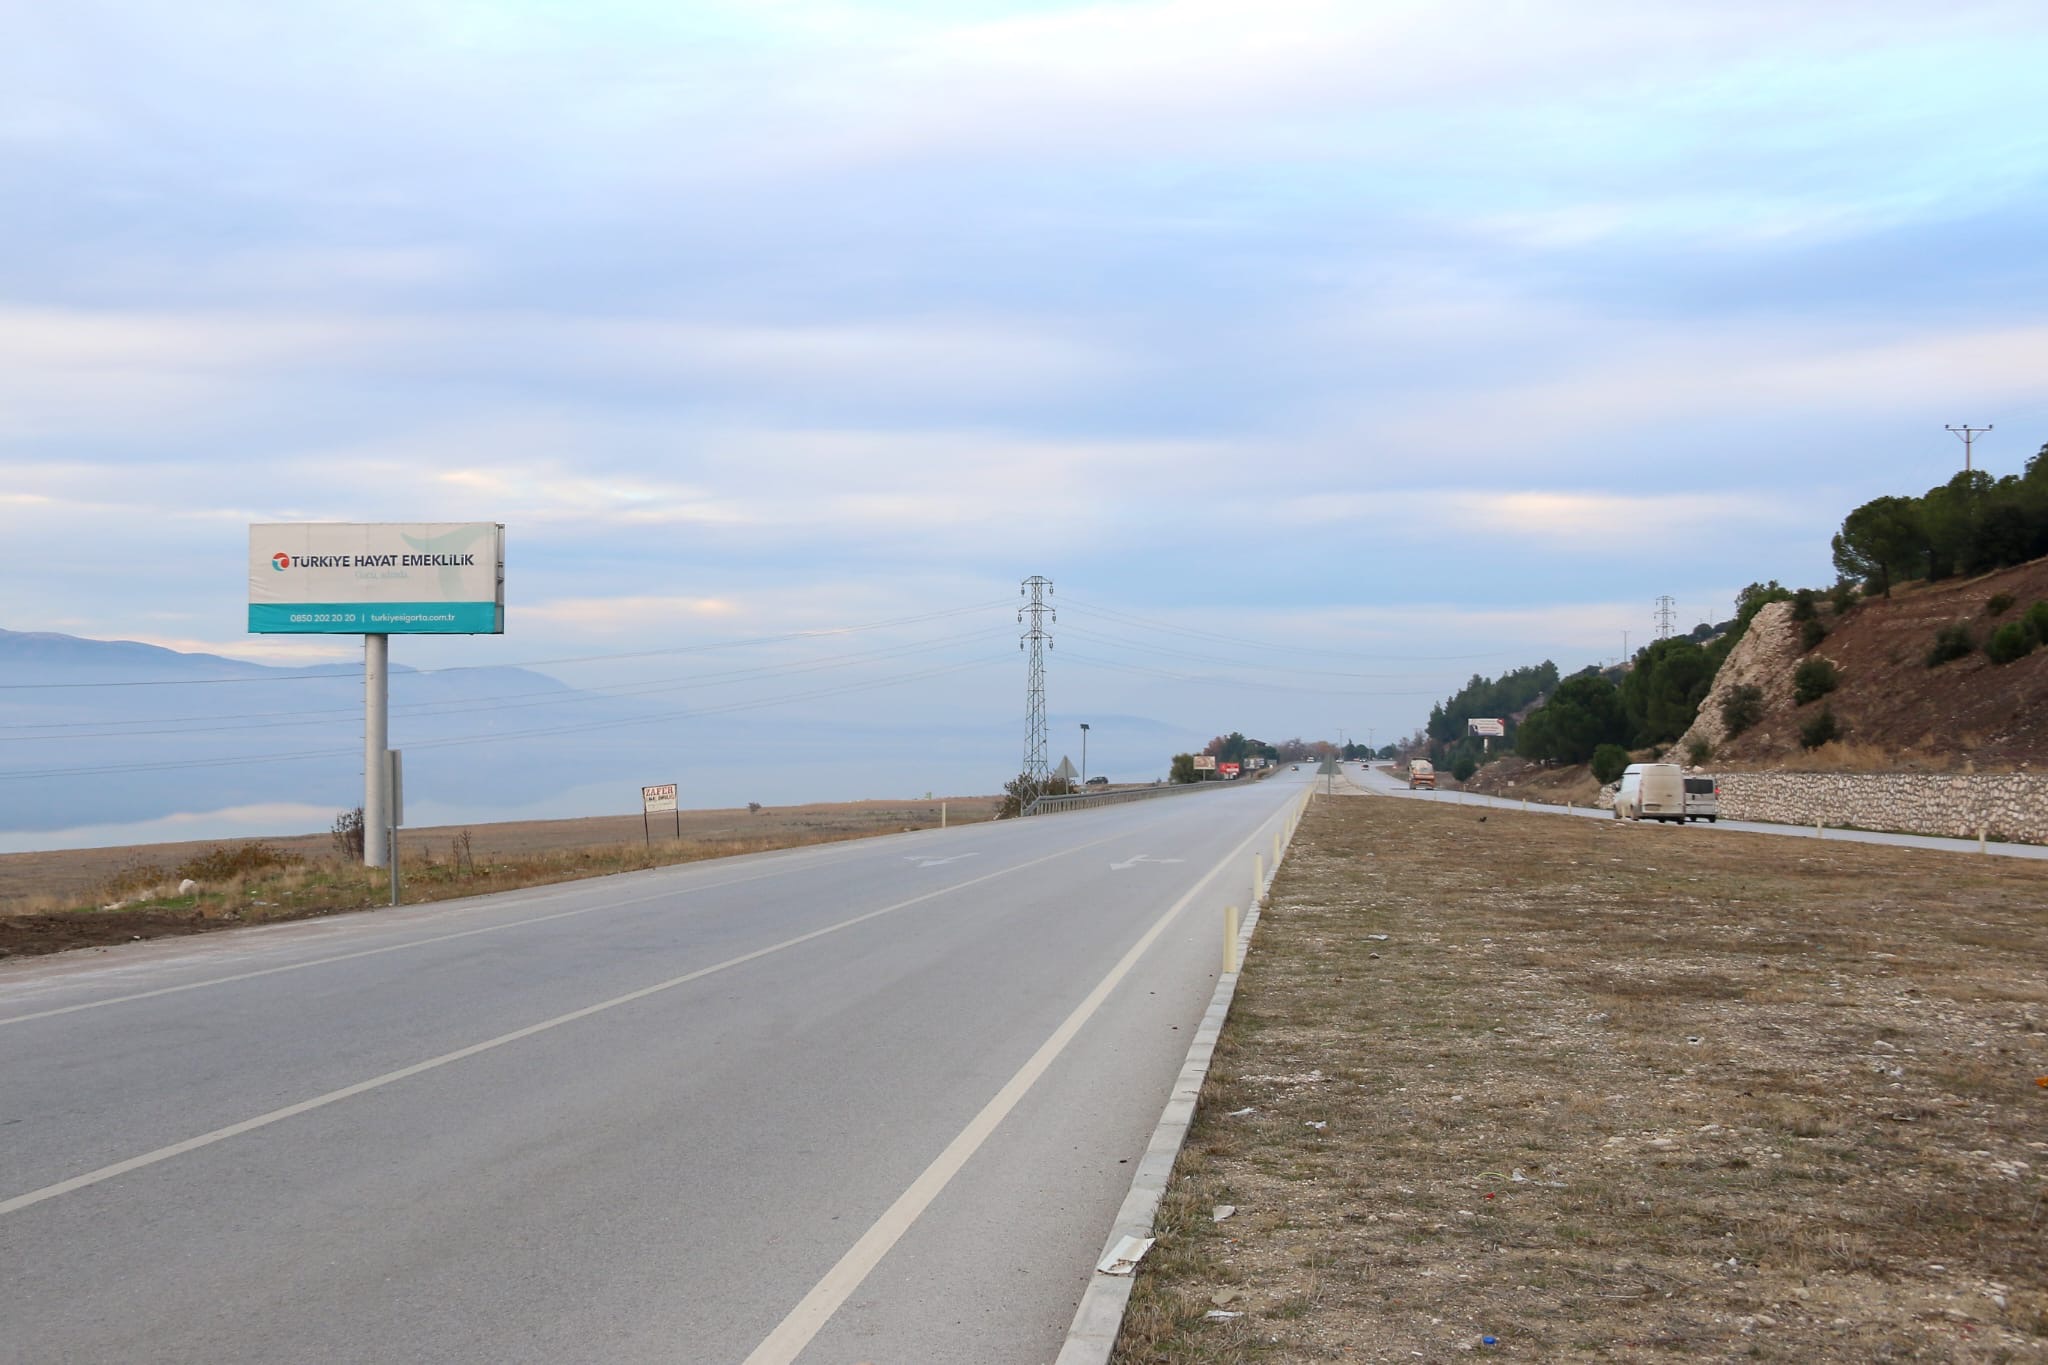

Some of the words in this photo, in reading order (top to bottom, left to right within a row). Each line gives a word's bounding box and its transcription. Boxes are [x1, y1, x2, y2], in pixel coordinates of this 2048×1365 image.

[354, 554, 398, 567] HAYAT
[290, 614, 312, 622] 0850
[314, 614, 330, 622] 202
[331, 614, 343, 622] 20
[344, 614, 356, 622] 20
[371, 613, 455, 624] turkiyesigorta.com.tr
